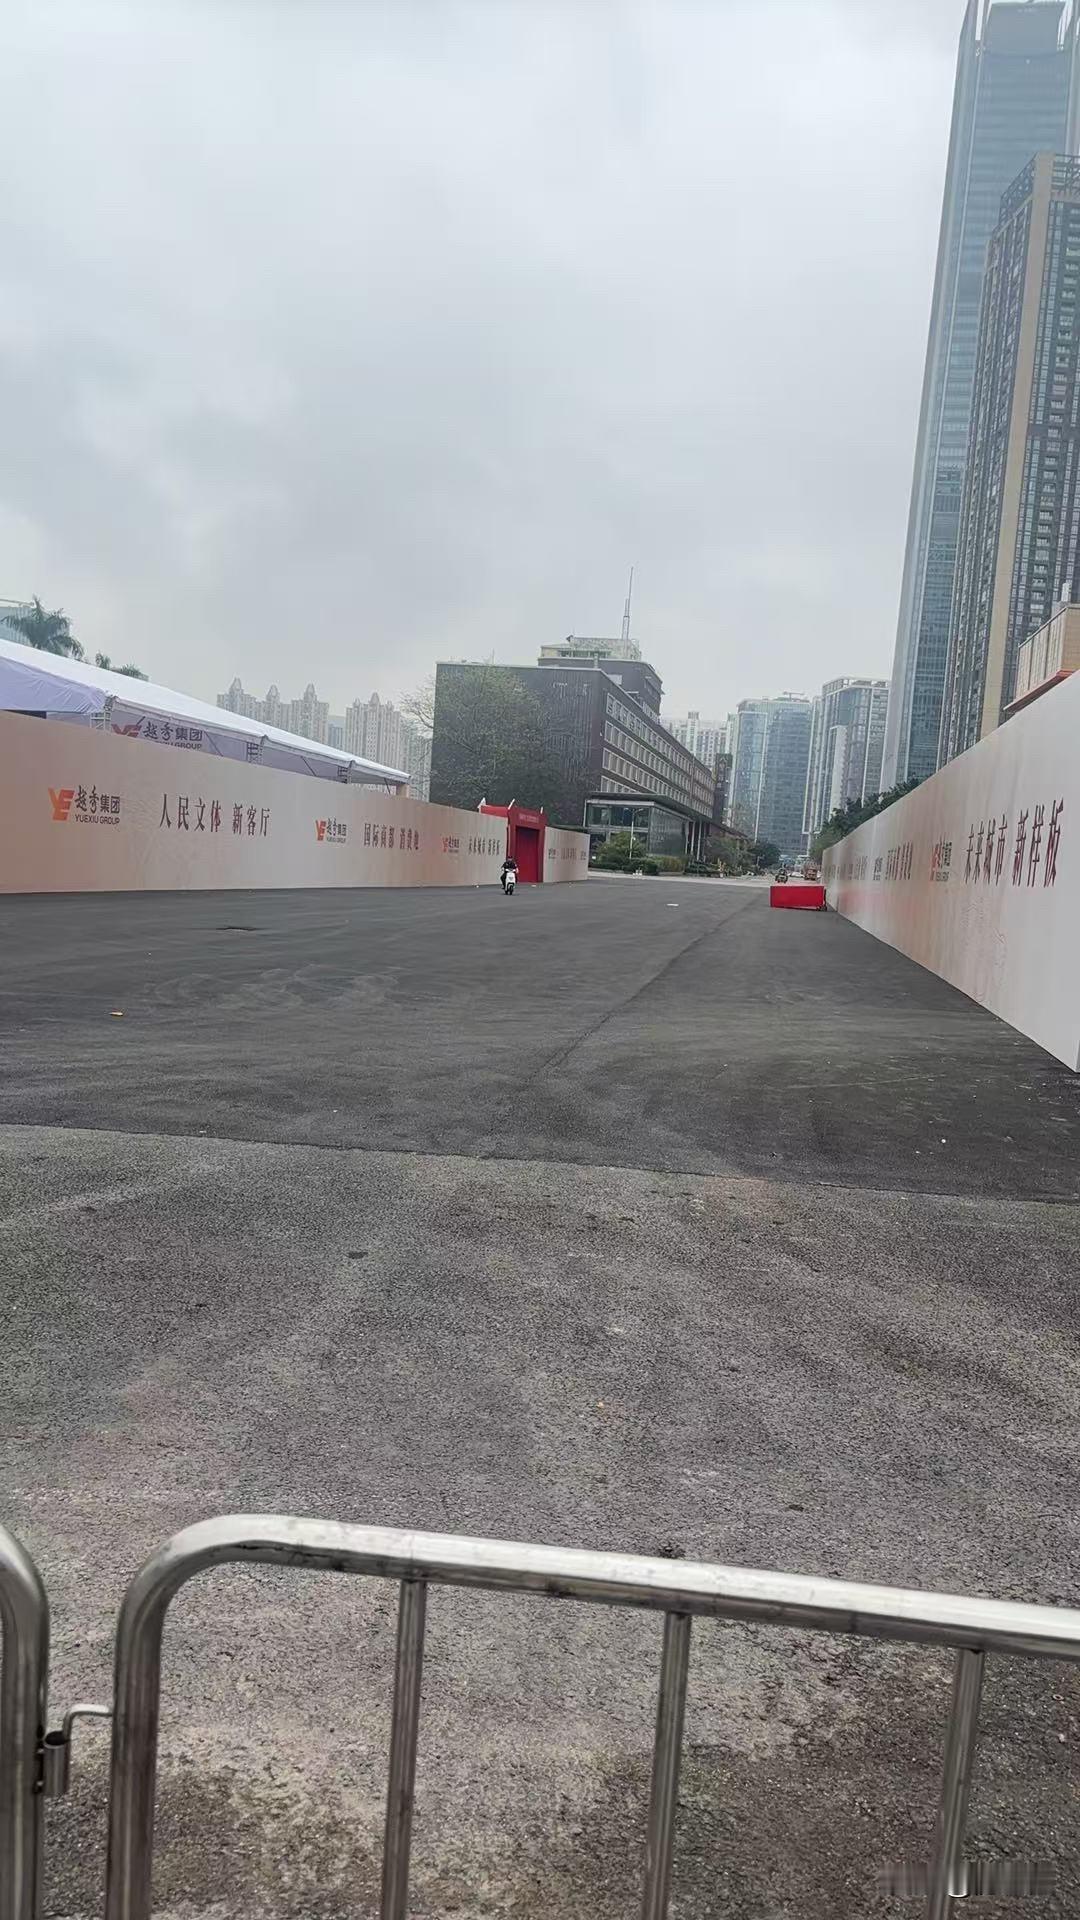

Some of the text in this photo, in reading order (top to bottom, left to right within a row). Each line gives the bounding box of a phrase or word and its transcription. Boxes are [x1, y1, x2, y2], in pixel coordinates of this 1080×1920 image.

[143, 721, 203, 742] 越秀集团
[75, 785, 120, 814] 越秀集团
[75, 813, 120, 825] YUEXIU GROUP
[159, 793, 271, 837] 人民文体 新客厅
[963, 813, 1008, 886] 未来城市
[1012, 797, 1064, 888] 新样板
